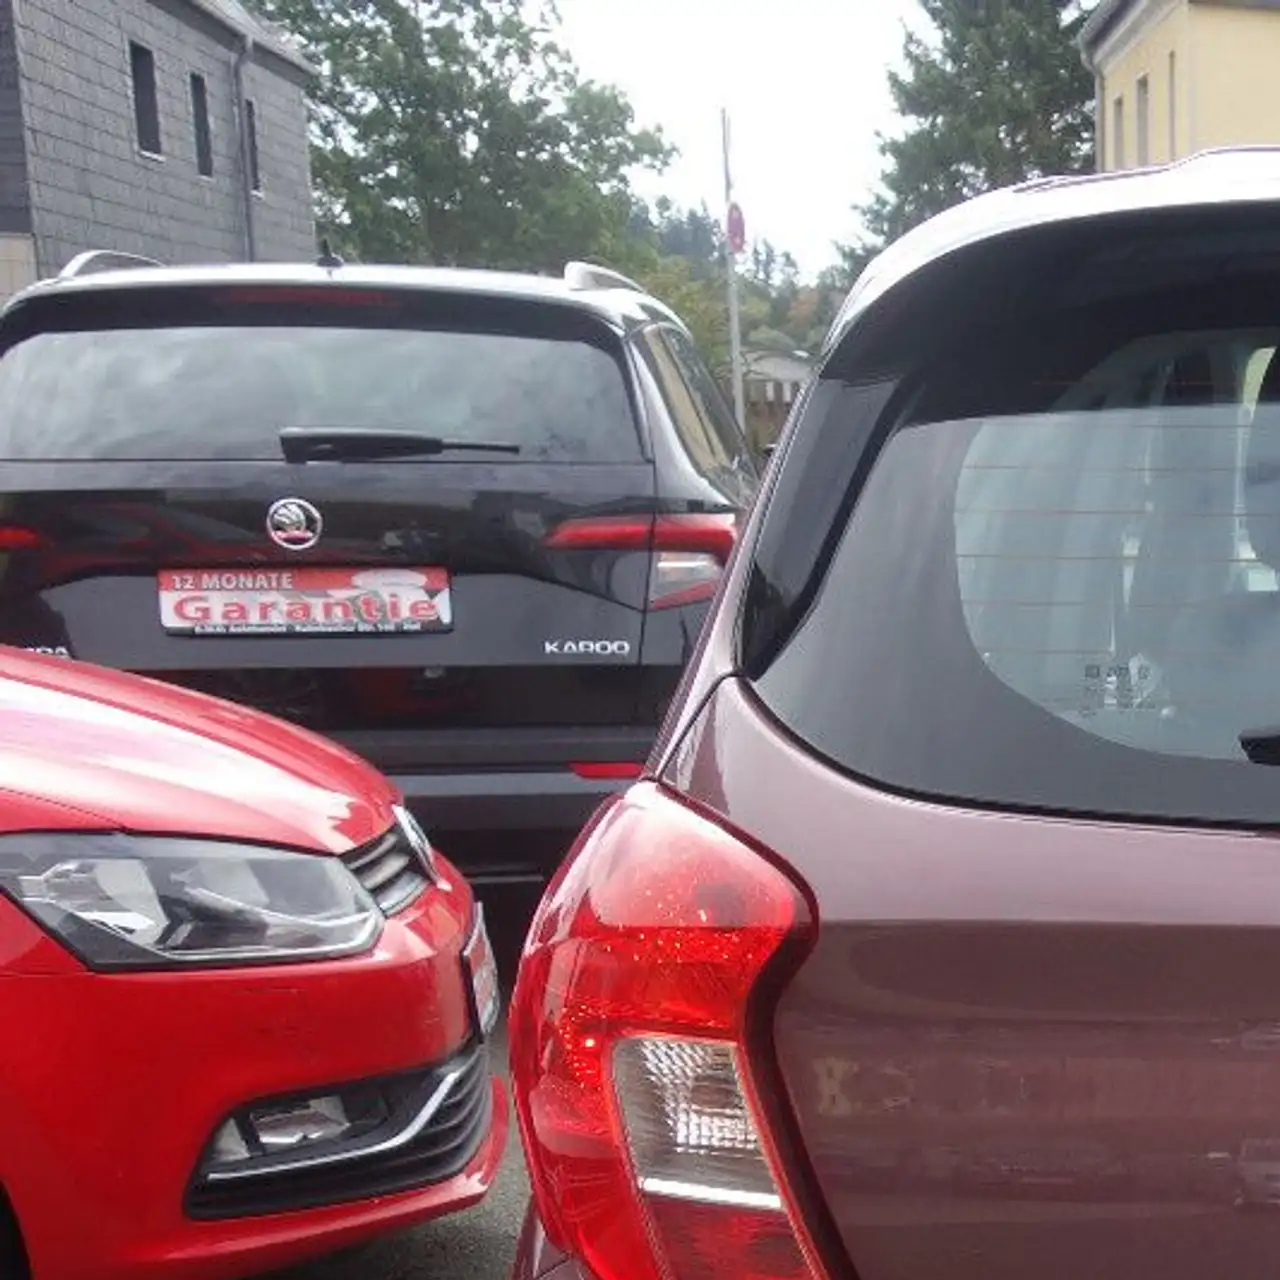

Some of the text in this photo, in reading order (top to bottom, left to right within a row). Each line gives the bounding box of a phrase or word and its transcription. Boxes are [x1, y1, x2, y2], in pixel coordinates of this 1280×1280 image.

[172, 572, 293, 589] 12 MONATE
[173, 594, 438, 623] Garantie
